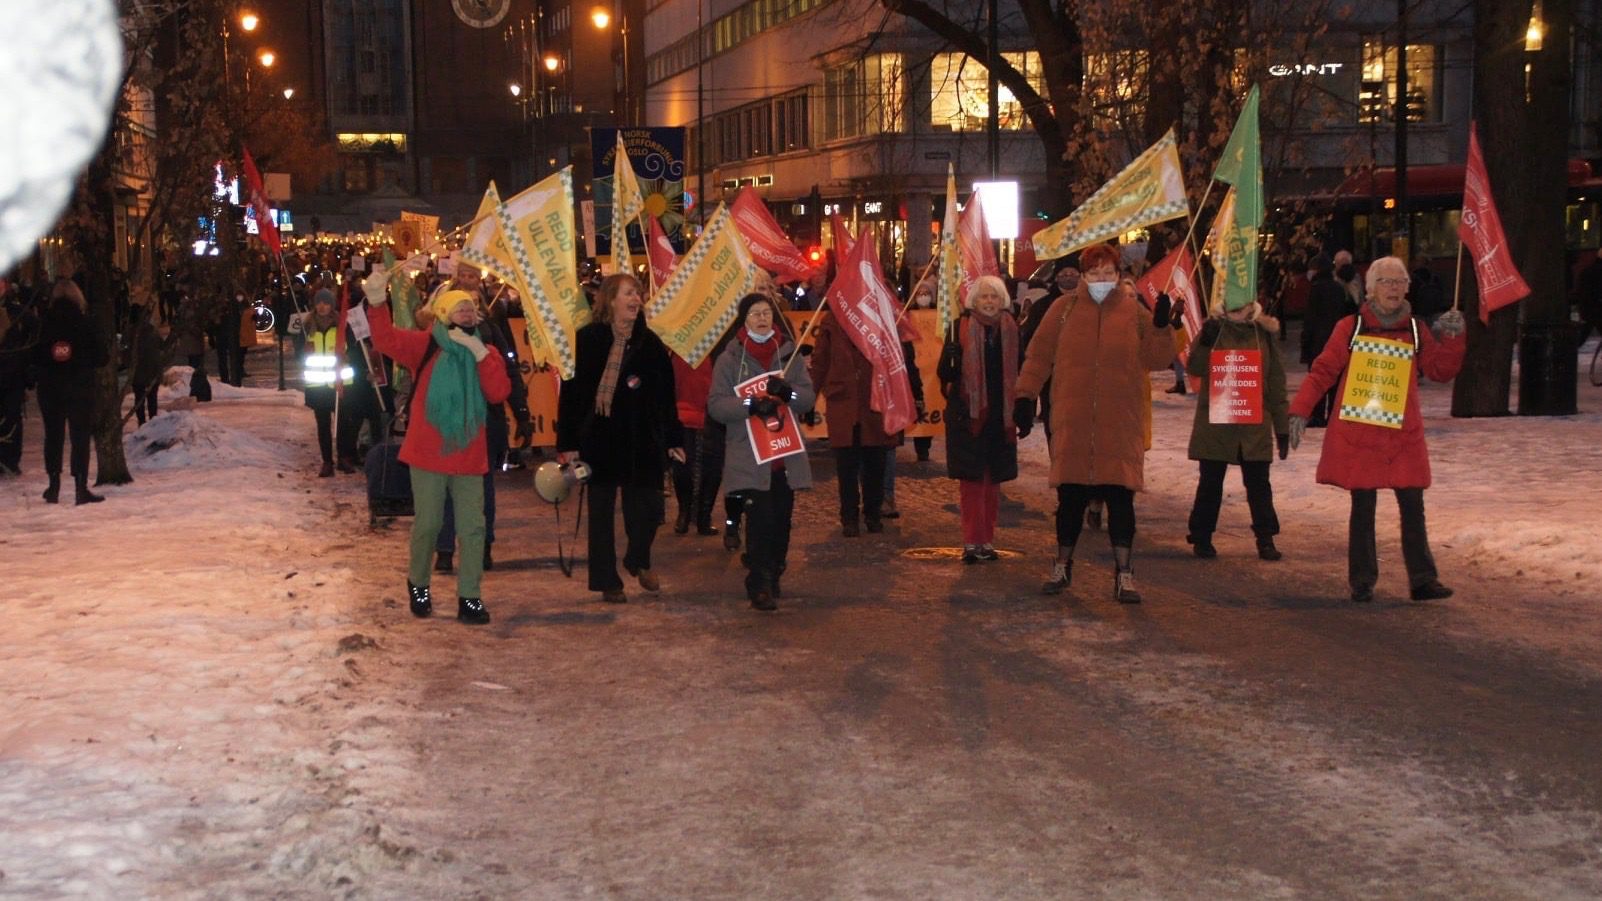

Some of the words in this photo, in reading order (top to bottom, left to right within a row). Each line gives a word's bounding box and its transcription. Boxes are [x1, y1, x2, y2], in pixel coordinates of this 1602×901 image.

[624, 129, 653, 139] NORSK
[627, 147, 649, 156] OSLO
[545, 211, 573, 253] REDD
[845, 309, 869, 338] HELE
[1224, 354, 1248, 362] OSLO-
[1366, 358, 1397, 371] REDD
[1211, 365, 1260, 373] SYKEHUSENE
[1355, 372, 1401, 388] ULLEVÅL
[744, 379, 769, 397] STO
[1351, 387, 1400, 403] SYKEHUS
[770, 437, 791, 450] SNU
